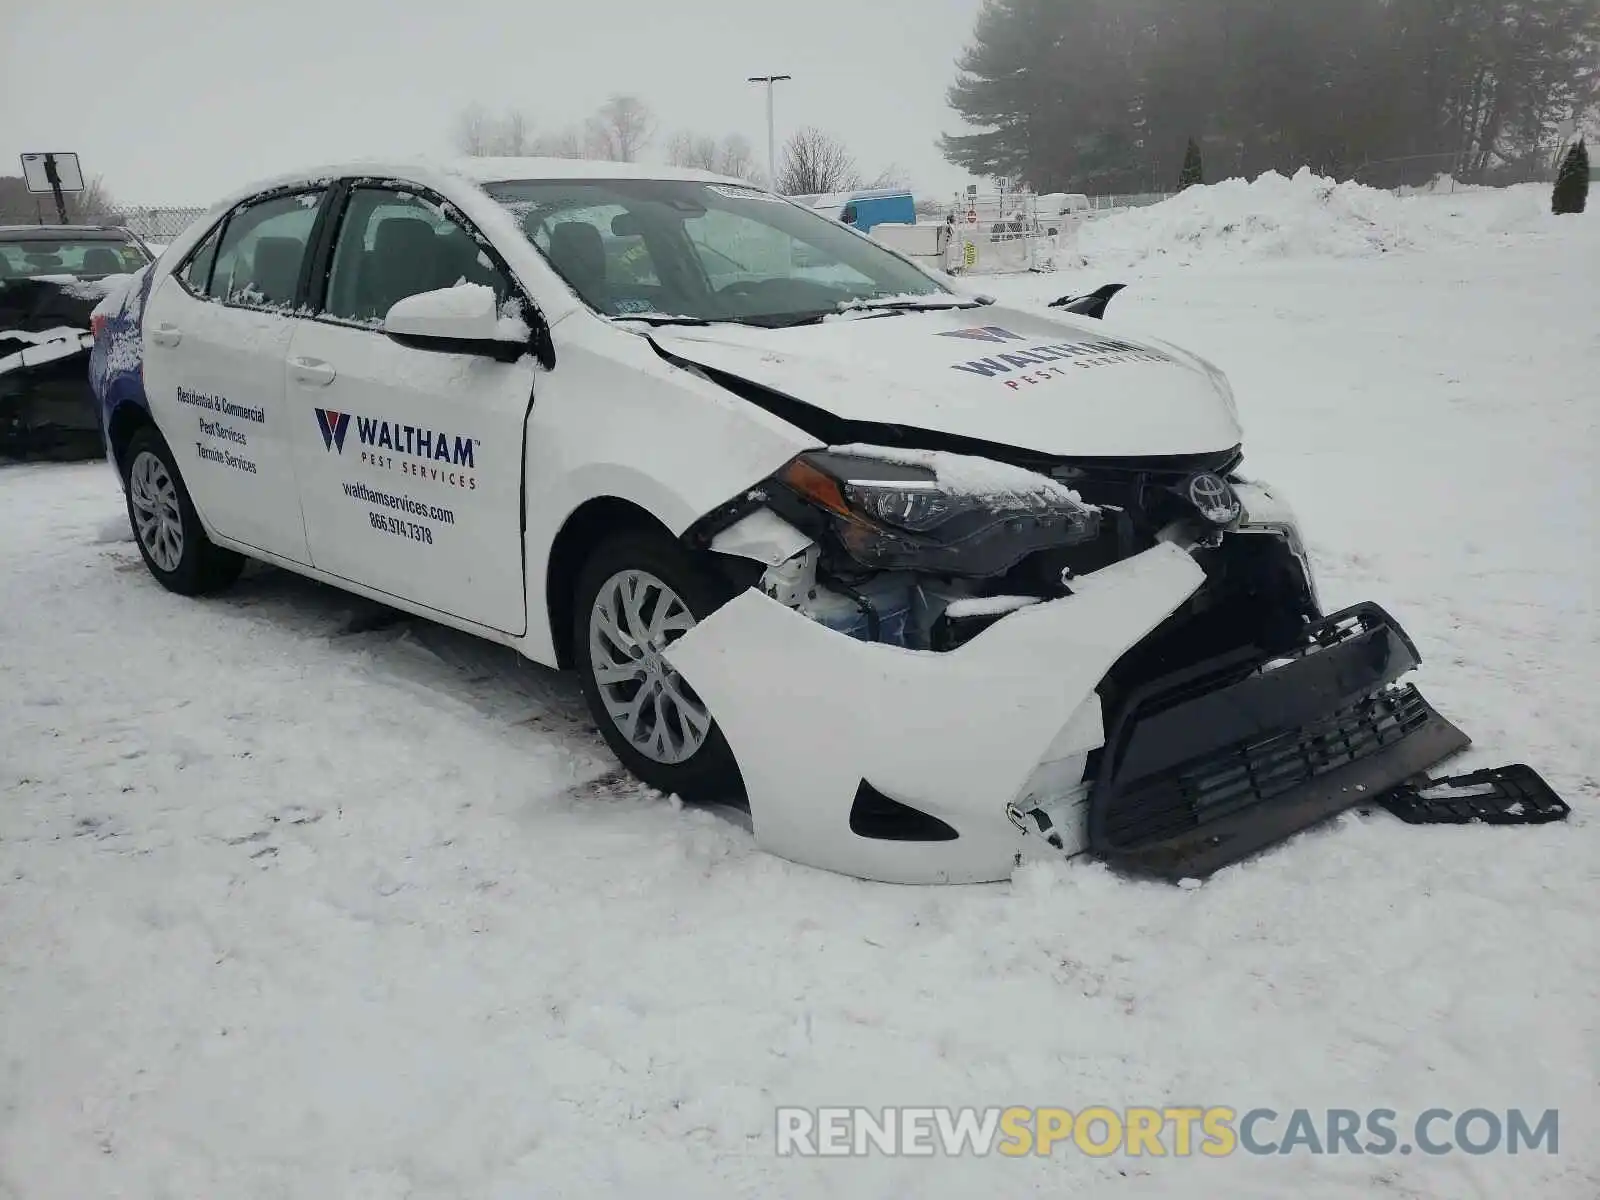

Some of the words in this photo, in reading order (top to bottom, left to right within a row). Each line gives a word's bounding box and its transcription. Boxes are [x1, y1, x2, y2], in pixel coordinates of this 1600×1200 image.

[951, 341, 1145, 377] WALTHAM
[1004, 367, 1065, 391] PEST
[177, 386, 214, 410] Residential
[214, 395, 221, 412] &
[221, 397, 265, 423] Commercial
[199, 417, 215, 436] Pest
[215, 422, 246, 446] Services
[357, 416, 475, 468] WALTHAM
[195, 442, 224, 464] Termite
[224, 450, 257, 474] Services
[361, 452, 392, 470] PEST
[402, 462, 476, 490] SERVICES
[342, 481, 455, 524] walthamservices.com
[369, 512, 433, 545] 866.974.7378
